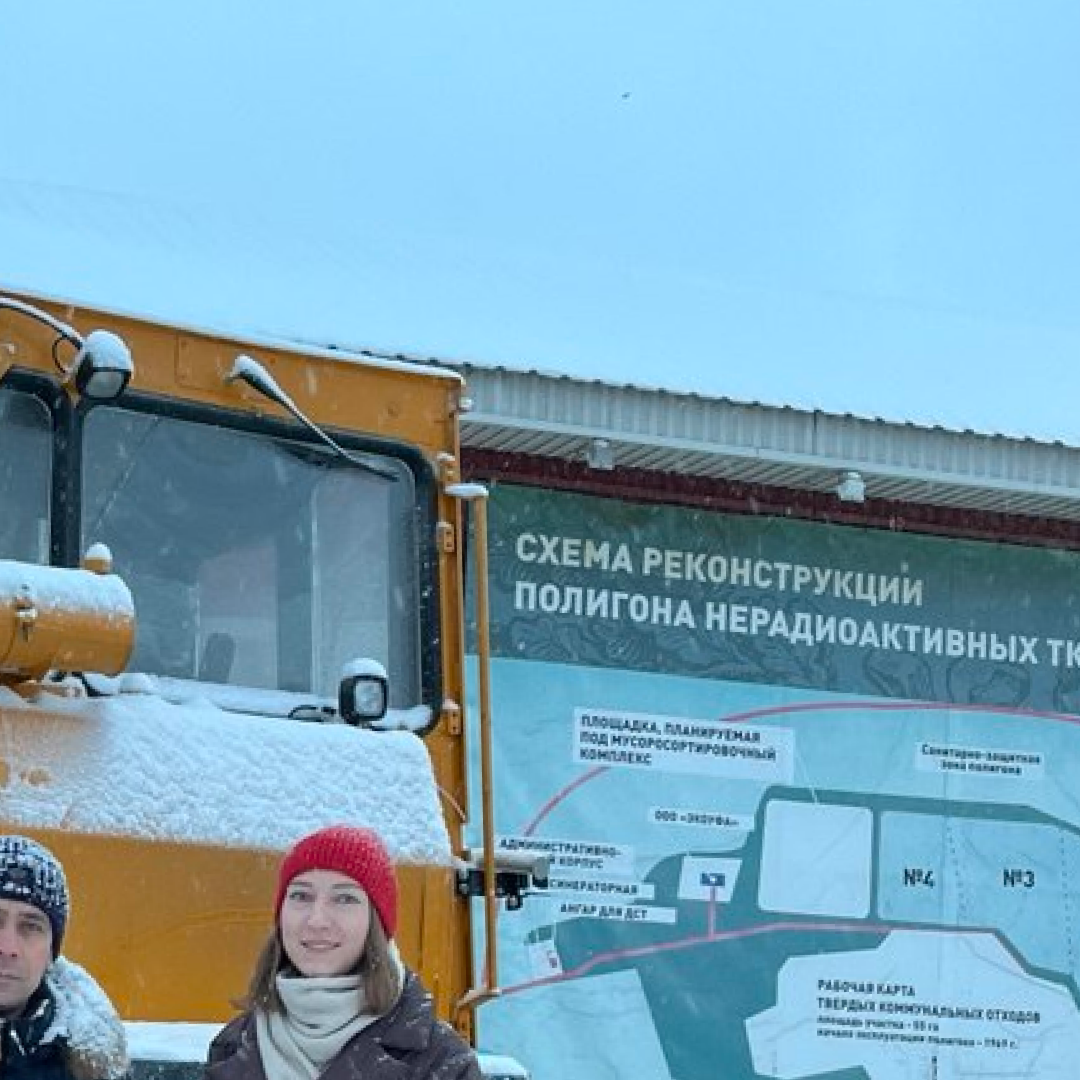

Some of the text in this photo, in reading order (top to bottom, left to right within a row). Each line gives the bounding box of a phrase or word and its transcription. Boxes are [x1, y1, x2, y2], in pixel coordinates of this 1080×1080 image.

[515, 533, 923, 607] СХЕМА РЕКОНСТРУКЦИИ
[515, 581, 1080, 668] ПОЛИГОНА НЕРАДИОАКТИВНЫХ ТК
[581, 714, 761, 743] ПЛОЩАДКА, ПЛАНИРУЕМАЯ
[580, 731, 777, 761] ПОД МУСОРОСОРТИРОВОЧНЫЙ
[580, 748, 652, 765] КОМПЛЕКС
[560, 857, 604, 869] КОРПУС
[550, 879, 639, 895] СИНЕРАТОРНАЯ
[904, 868, 1035, 888] №4 №3
[560, 903, 597, 915] АНГАР
[599, 906, 623, 918] ДЛЯ
[817, 979, 916, 997] РАБОЧАЯ КАРТА
[817, 997, 1040, 1024] ТВЕРДЫХ КОММУНАЛЬНЫХ ОТХОДОВ
